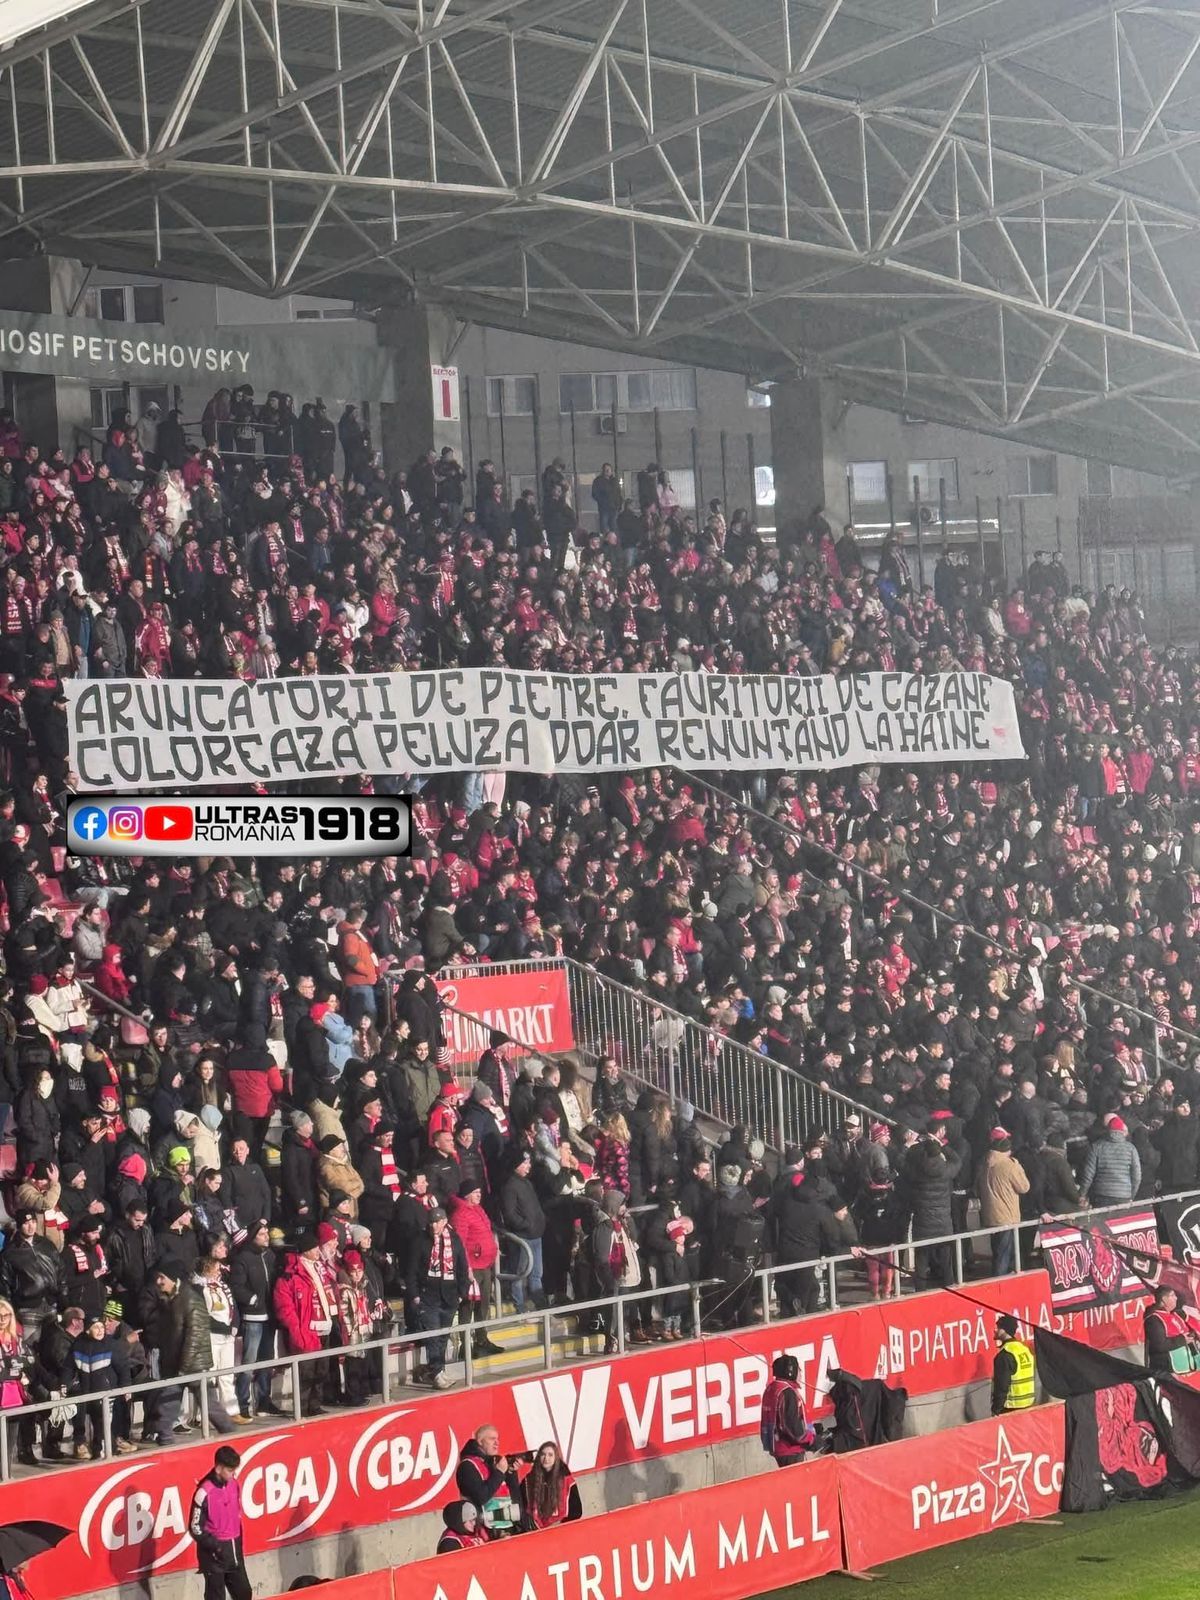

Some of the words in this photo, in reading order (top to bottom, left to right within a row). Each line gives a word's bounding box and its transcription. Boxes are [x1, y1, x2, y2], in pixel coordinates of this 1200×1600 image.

[0, 329, 65, 357] IOSIF
[72, 335, 250, 373] PETSCHOVSKY
[410, 671, 466, 717] DE
[836, 673, 873, 712] DE
[882, 673, 992, 713] CAZANE
[373, 718, 529, 767] PELUZA
[549, 719, 641, 766] DOAR
[909, 1309, 989, 1366] PIATRĂ
[241, 1457, 319, 1519] CBA
[367, 1431, 441, 1491] CBA
[101, 1486, 186, 1550] CBA
[911, 1480, 986, 1529] Pizza
[519, 1530, 697, 1600] ATRIUM
[719, 1496, 830, 1569] MALL
